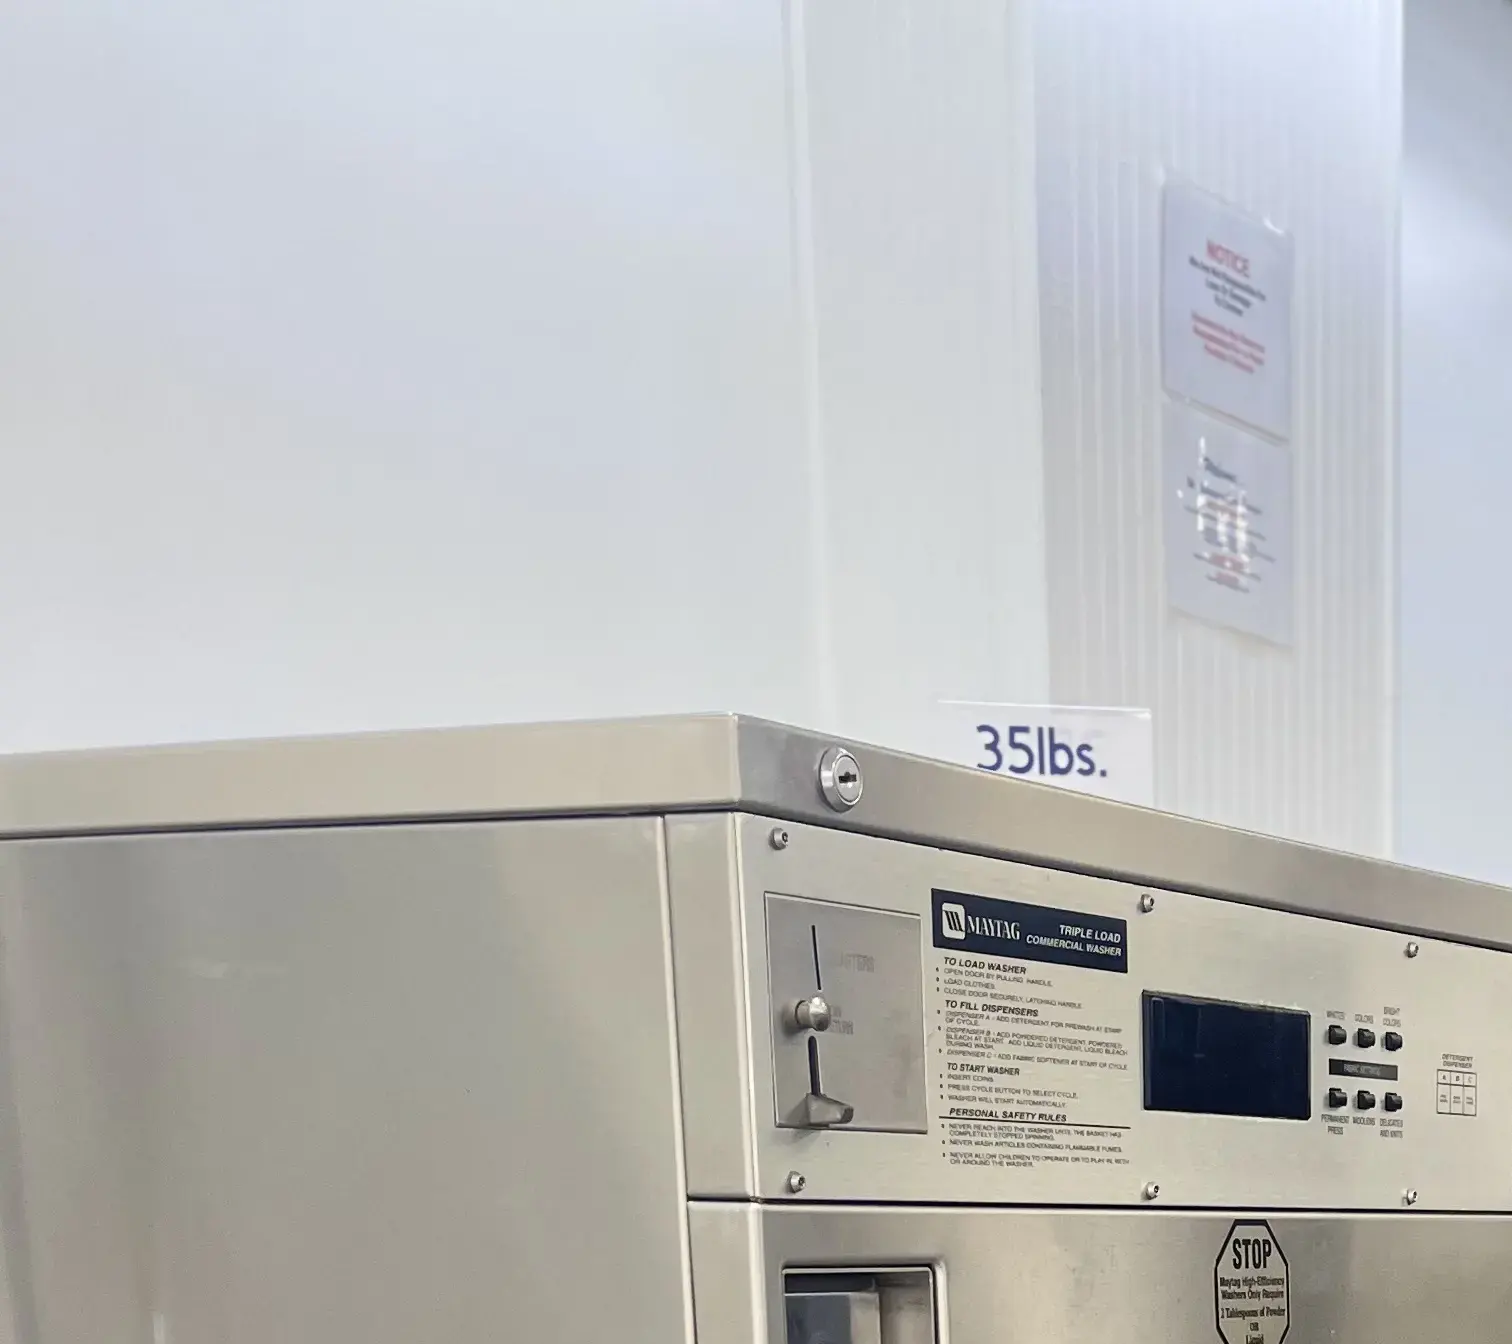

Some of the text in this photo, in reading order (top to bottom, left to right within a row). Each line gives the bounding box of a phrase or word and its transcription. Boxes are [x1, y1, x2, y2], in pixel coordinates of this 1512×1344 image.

[1206, 238, 1250, 278] NOTICE
[976, 724, 1107, 777] 35lbs.
[968, 914, 1020, 940] MAYTAG
[1059, 925, 1121, 944] TRIPLE LOAD
[1026, 935, 1122, 956] COMMERCIAL WASHER
[944, 957, 1026, 975] TO LOAD WASHER
[945, 999, 1038, 1017] TO FILL DISPENSERS
[947, 1062, 1020, 1076] TO START WASHER
[949, 1107, 1067, 1122] PERSONAL SAFETY RULES
[1233, 1238, 1272, 1270] STOP
[1220, 1277, 1240, 1289] Maytag
[1248, 1289, 1261, 1301] Only
[1266, 1306, 1285, 1316] Powder
[1250, 1322, 1259, 1331] OR
